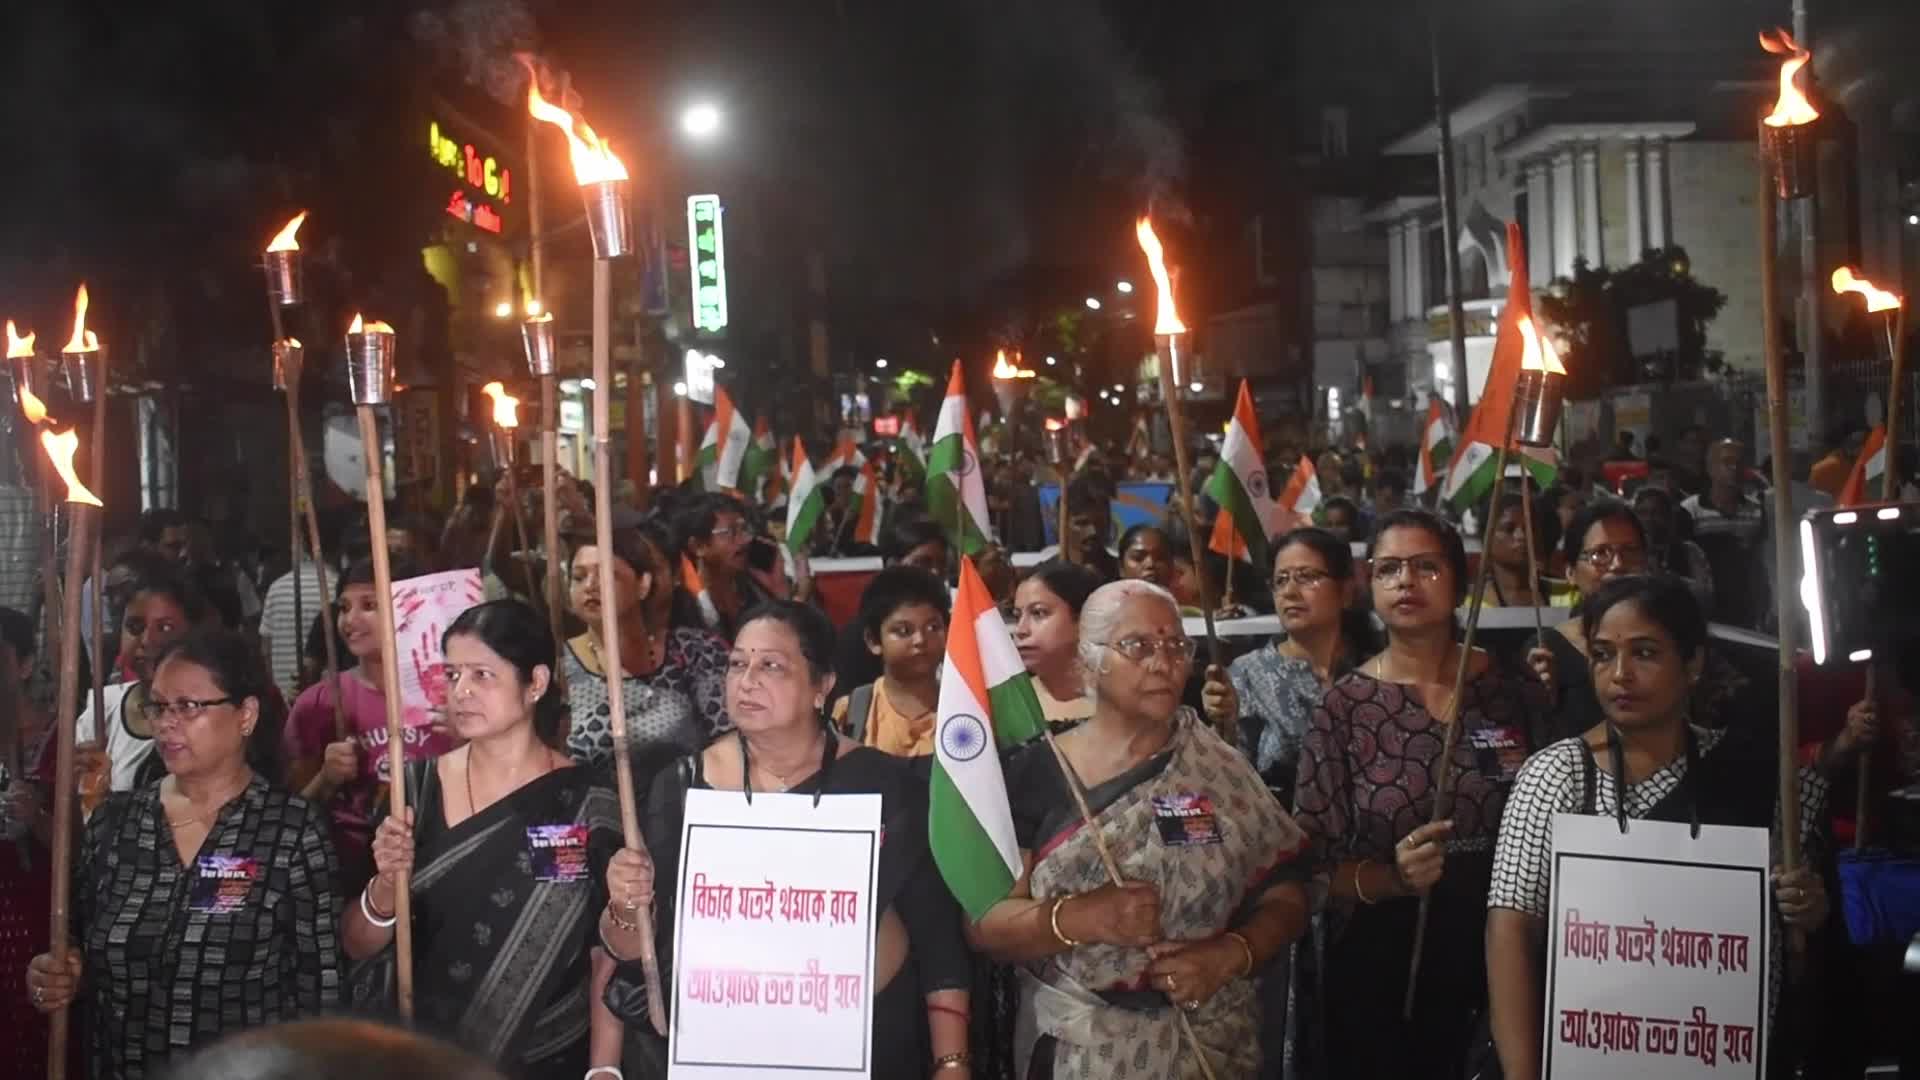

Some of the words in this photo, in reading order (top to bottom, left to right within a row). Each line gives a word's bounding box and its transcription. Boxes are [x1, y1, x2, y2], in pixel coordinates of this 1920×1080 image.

[358, 727, 431, 750] HUSY
[692, 872, 734, 923] বিচার
[738, 877, 776, 922] যতই
[780, 885, 827, 922] থমকে
[830, 890, 858, 927] রবে
[1564, 908, 1610, 965] বিচার
[1615, 915, 1658, 966] যতই
[1661, 925, 1713, 968] থমকে
[1717, 934, 1749, 975] রবে
[688, 969, 761, 1008] আওয়াজ
[763, 971, 795, 1005] তত
[798, 959, 829, 1014] তীব্র
[834, 973, 861, 1008] হবে
[1560, 1009, 1643, 1055] আওয়াজ
[1646, 1017, 1680, 1055] তত
[1684, 1006, 1719, 1067] তীব্র
[1723, 1024, 1754, 1064] হবে
